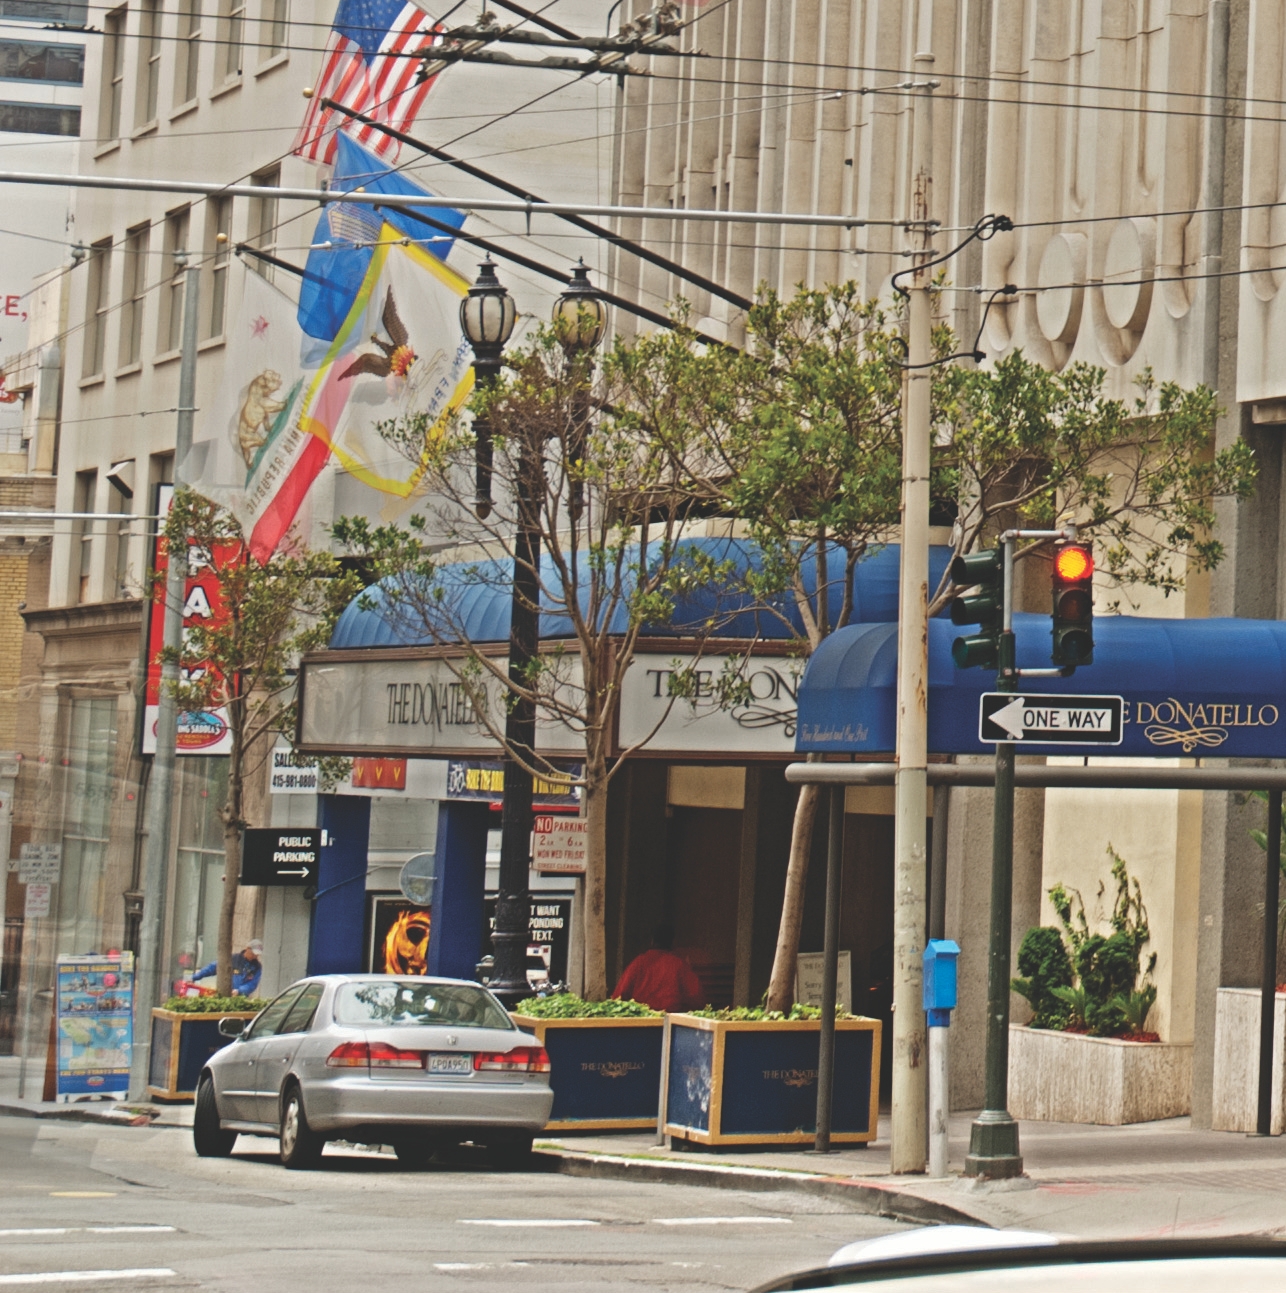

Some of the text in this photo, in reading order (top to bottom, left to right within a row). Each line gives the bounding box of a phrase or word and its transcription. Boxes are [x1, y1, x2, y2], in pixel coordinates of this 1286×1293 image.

[0, 295, 28, 322] E,
[387, 682, 411, 725] THE
[1136, 697, 1279, 727] DONATELLO
[1023, 709, 1061, 728] ONE
[1066, 710, 1107, 729] WAY
[536, 818, 552, 833] NO
[278, 836, 312, 847] PUBLIC
[272, 851, 316, 862] PARKING
[537, 904, 561, 916] WANT
[528, 917, 564, 929] PONDING
[532, 929, 554, 941] TEXT.
[581, 1061, 645, 1071] THE DONATELLO
[762, 1069, 819, 1079] THE DONATEL
